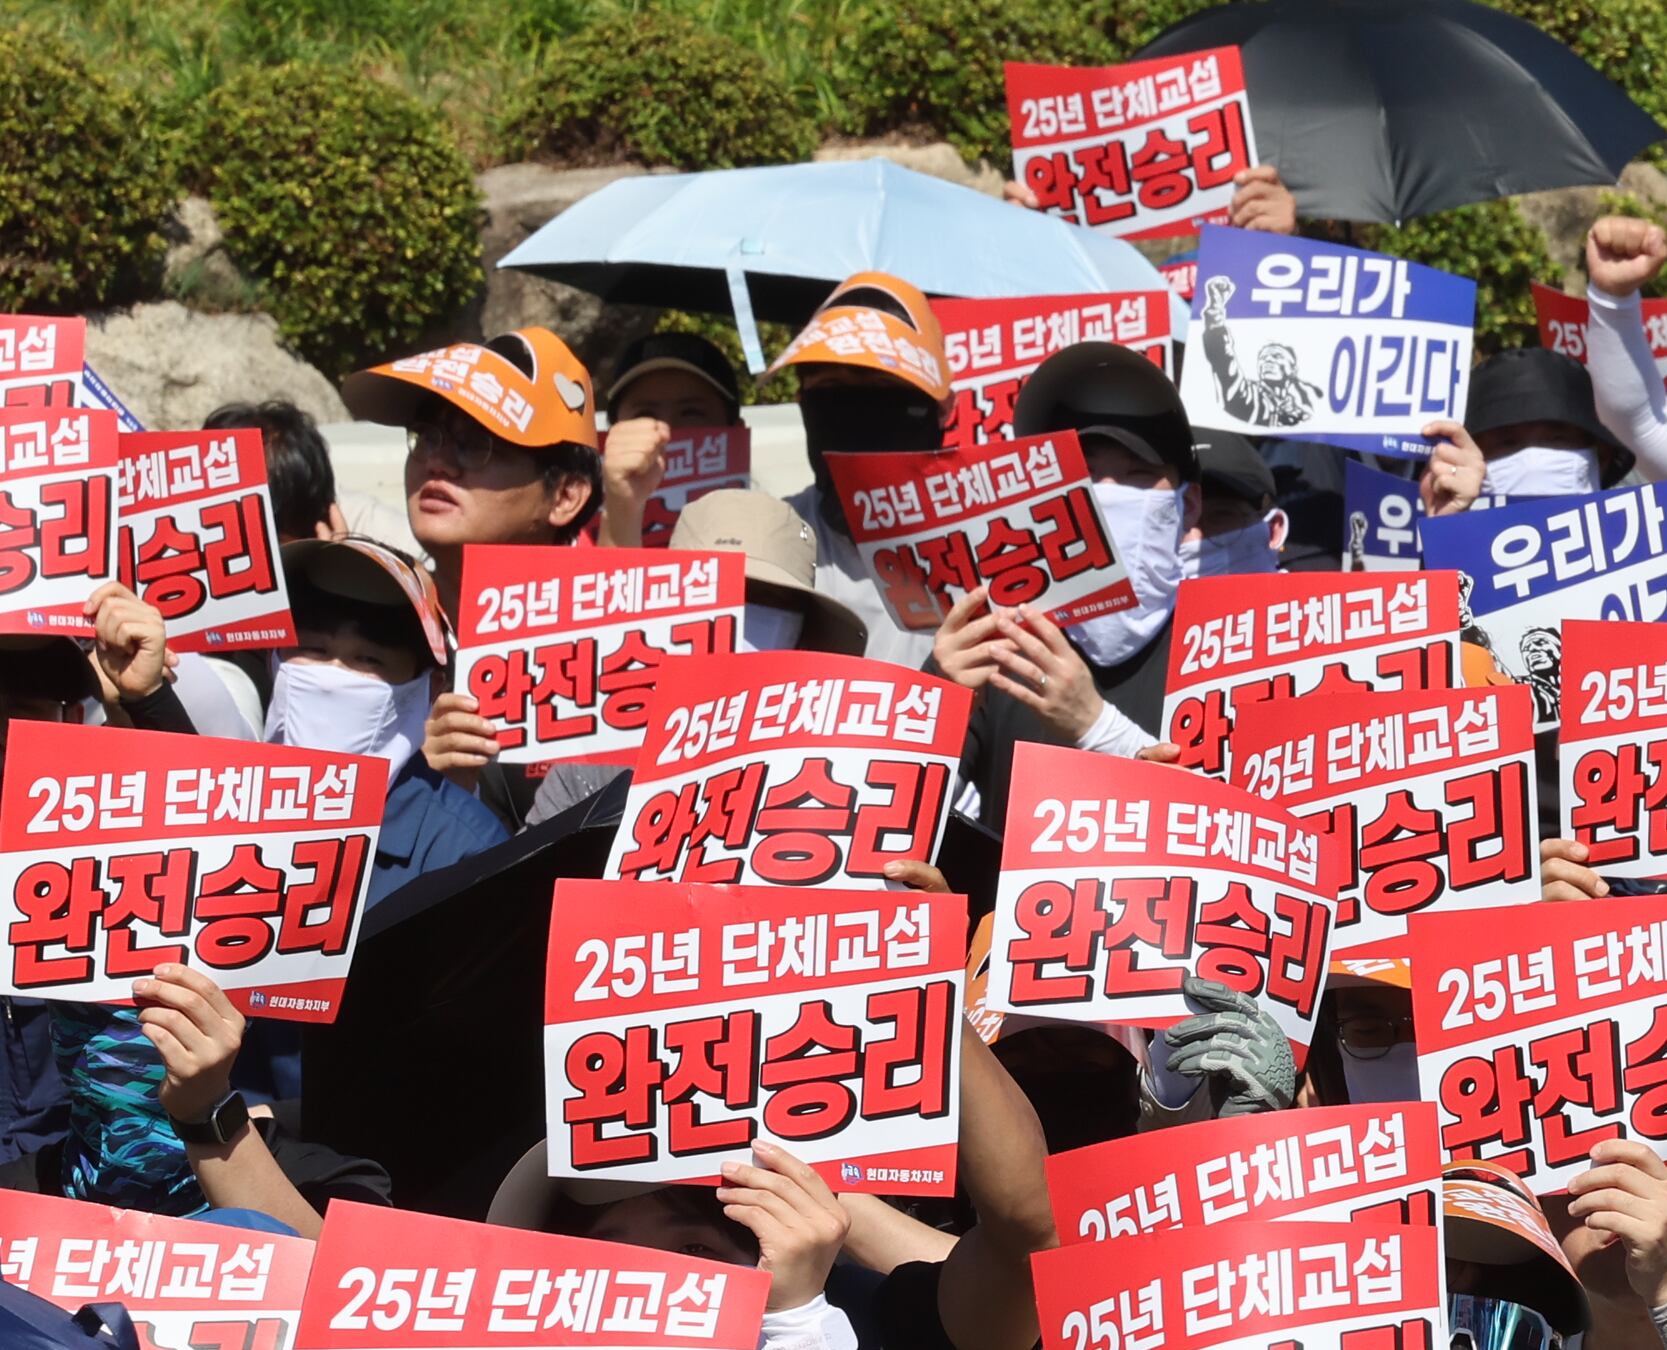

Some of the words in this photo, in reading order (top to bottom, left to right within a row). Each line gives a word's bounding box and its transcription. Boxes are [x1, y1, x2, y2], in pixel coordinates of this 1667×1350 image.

[1092, 56, 1220, 130] 단체교섭
[1251, 252, 1410, 318] 우리가
[1329, 332, 1460, 420] 이긴다
[932, 440, 1064, 515] 단체교섭
[1489, 484, 1664, 602] 우리가
[1265, 580, 1429, 656] 단체교섭
[751, 678, 941, 744] 단체교섭
[1325, 696, 1498, 782] 단체교섭
[27, 773, 143, 834] 25년
[163, 763, 359, 828] 단체교섭
[621, 755, 949, 886] 완전승리
[1030, 800, 1149, 854] 25년
[1164, 801, 1322, 884] 단체교섭
[11, 833, 371, 988] 완전승리
[1009, 875, 1332, 1021] 완전승리
[573, 933, 700, 1004] 25년
[719, 900, 932, 979] 단체교섭
[1438, 951, 1554, 1031] 25년
[271, 997, 330, 1014] 현대자동차지부
[565, 981, 955, 1172] 완전승리
[865, 1167, 944, 1185] 현대자동차지부
[1199, 1115, 1405, 1218] 단체교섭
[54, 1241, 274, 1300] 단체교섭
[329, 1267, 472, 1333] 25년
[489, 1269, 726, 1338] 단체교섭
[1182, 1236, 1403, 1336] 단체교섭
